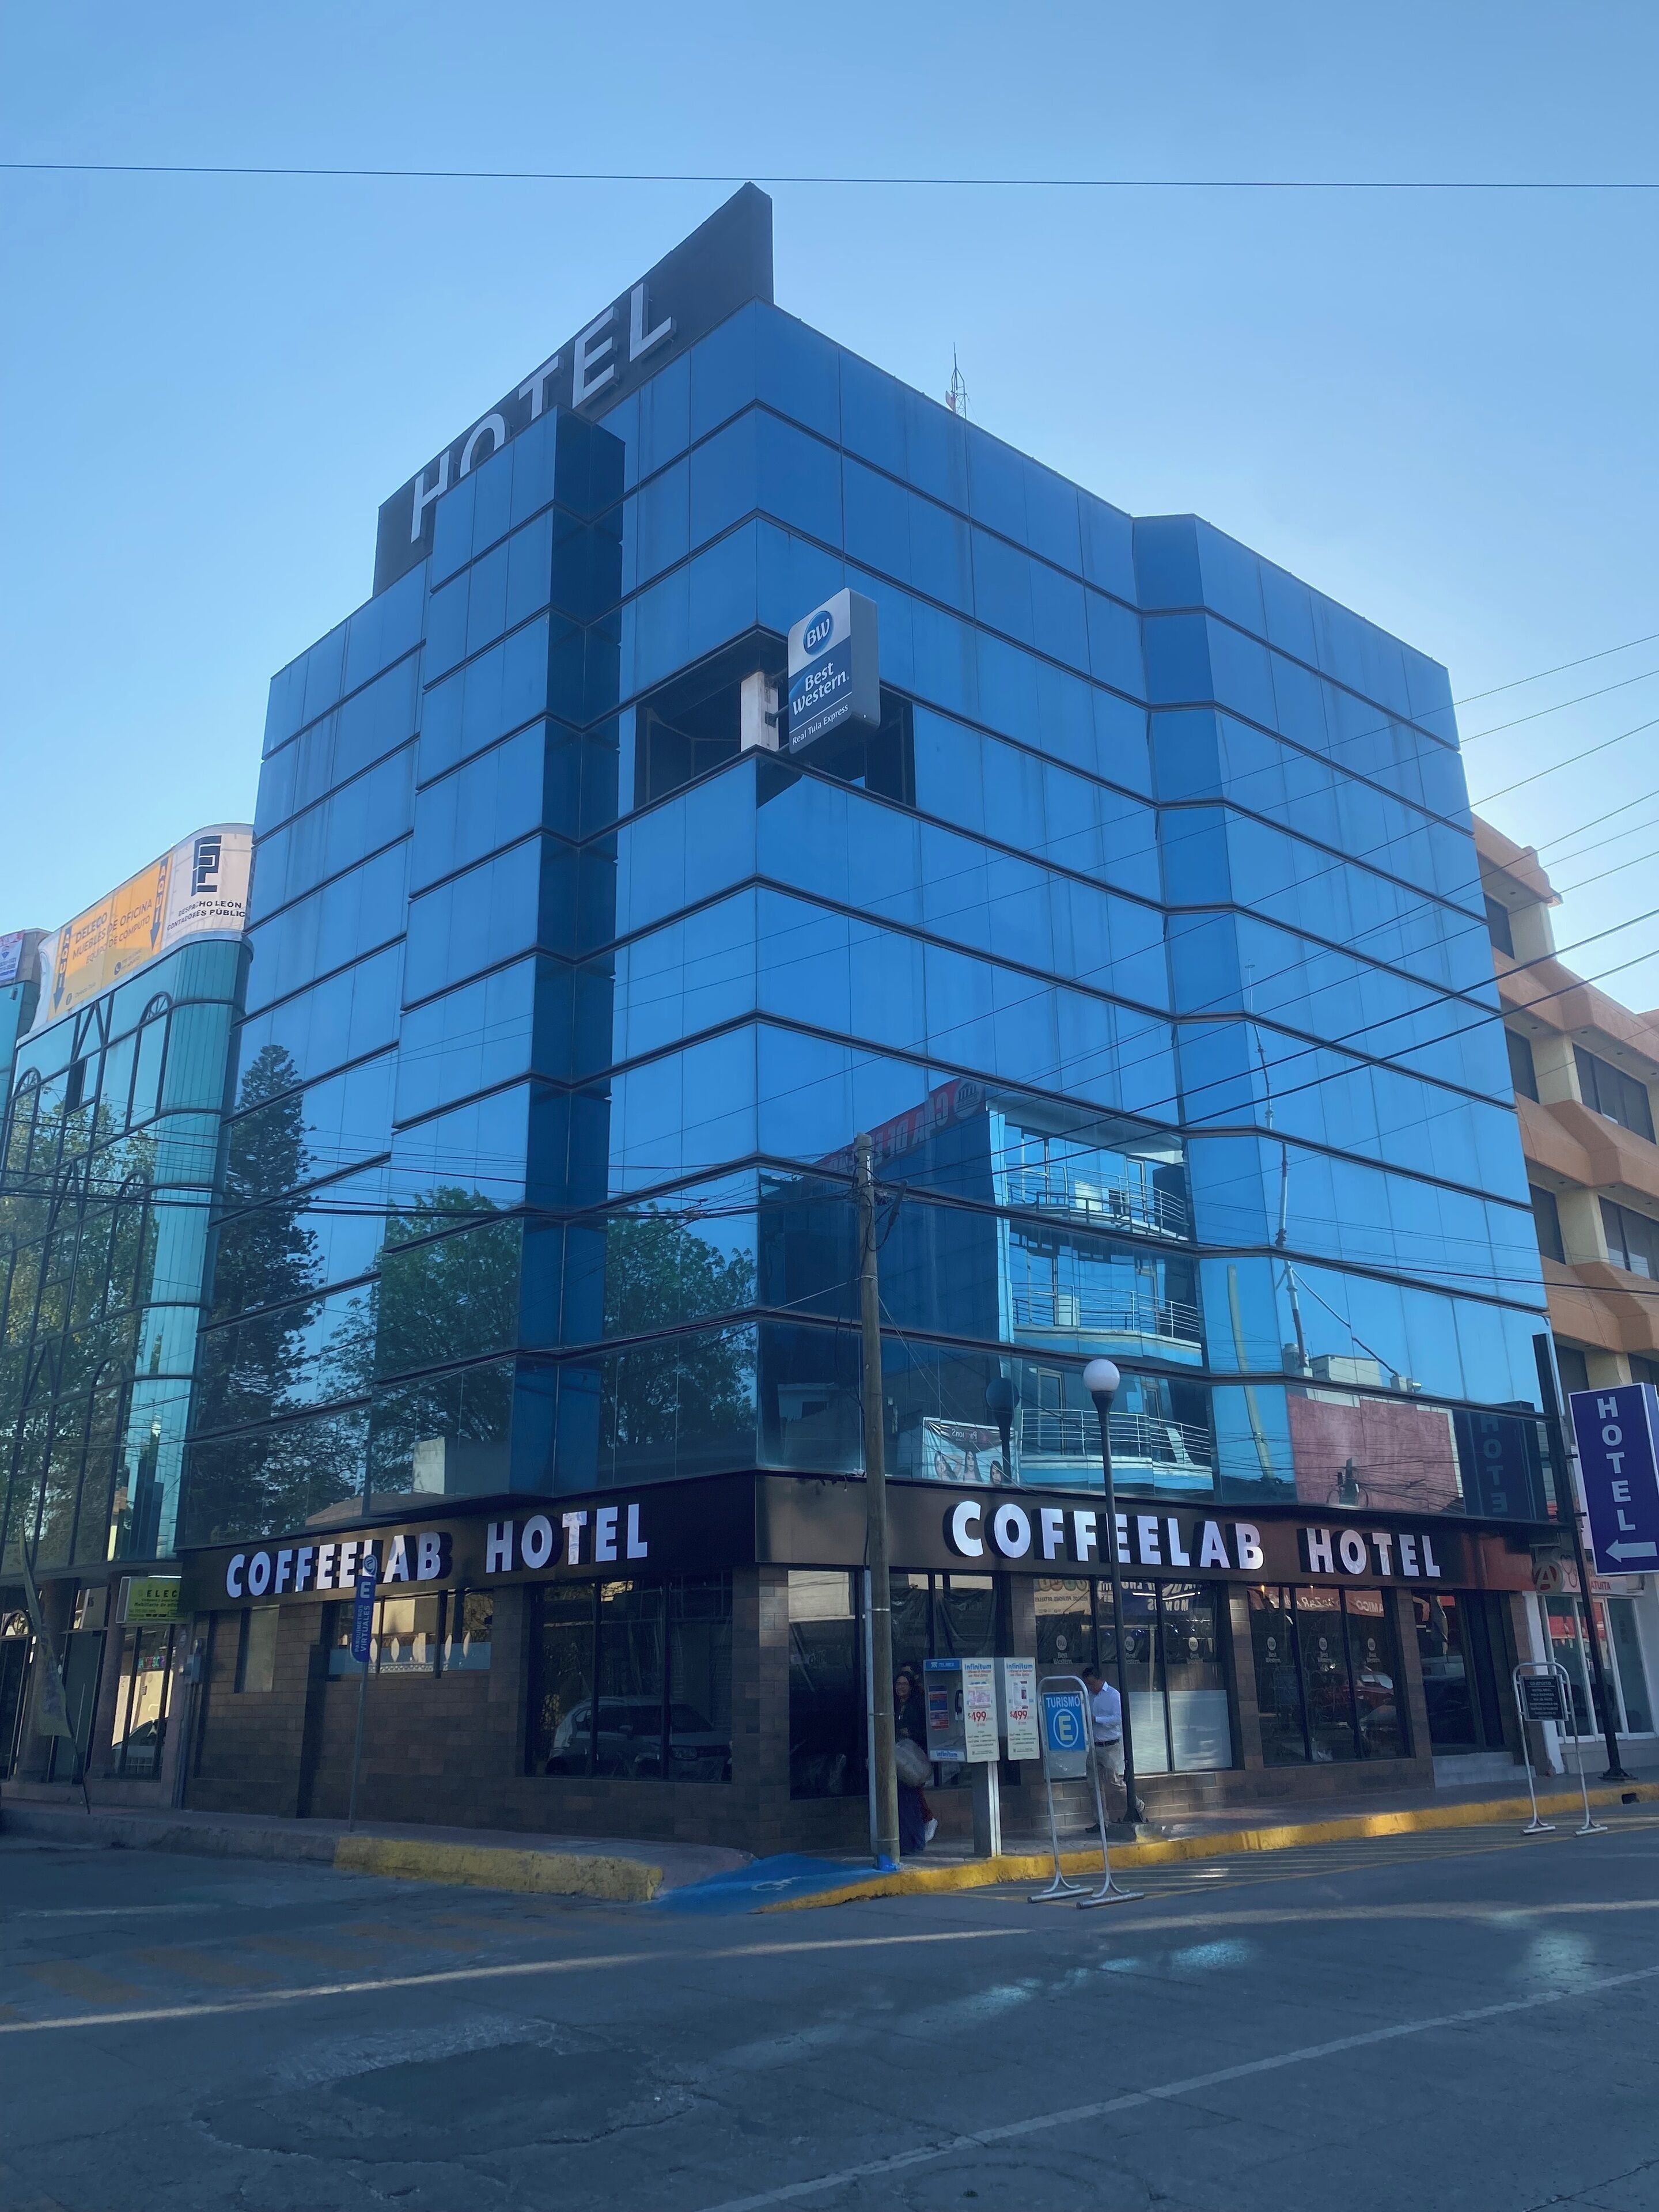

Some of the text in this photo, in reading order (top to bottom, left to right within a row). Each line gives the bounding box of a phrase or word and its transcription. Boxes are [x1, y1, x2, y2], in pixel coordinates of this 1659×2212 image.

[411, 282, 676, 544] HOTEL
[806, 618, 830, 649] BW
[793, 671, 847, 715] Western
[805, 662, 834, 691] Best
[792, 704, 849, 745] Real Tula Express
[167, 908, 245, 930] CONTADORES PÚBLIC
[178, 900, 242, 916] DESPACHO LEÓN
[73, 928, 106, 960] MUEBLES
[108, 919, 118, 932] DE
[120, 899, 152, 926] OFICINA
[75, 912, 107, 944] DELECO
[1597, 1396, 1636, 1531] HOTEL
[487, 1503, 648, 1574] HOTEL
[952, 1500, 1441, 1578] COFFEELAB HOTEL
[360, 1581, 372, 1599] E
[1590, 1581, 1611, 1590] ATUITA
[360, 1605, 370, 1652] VIRTUALES
[1058, 1715, 1074, 1741] E
